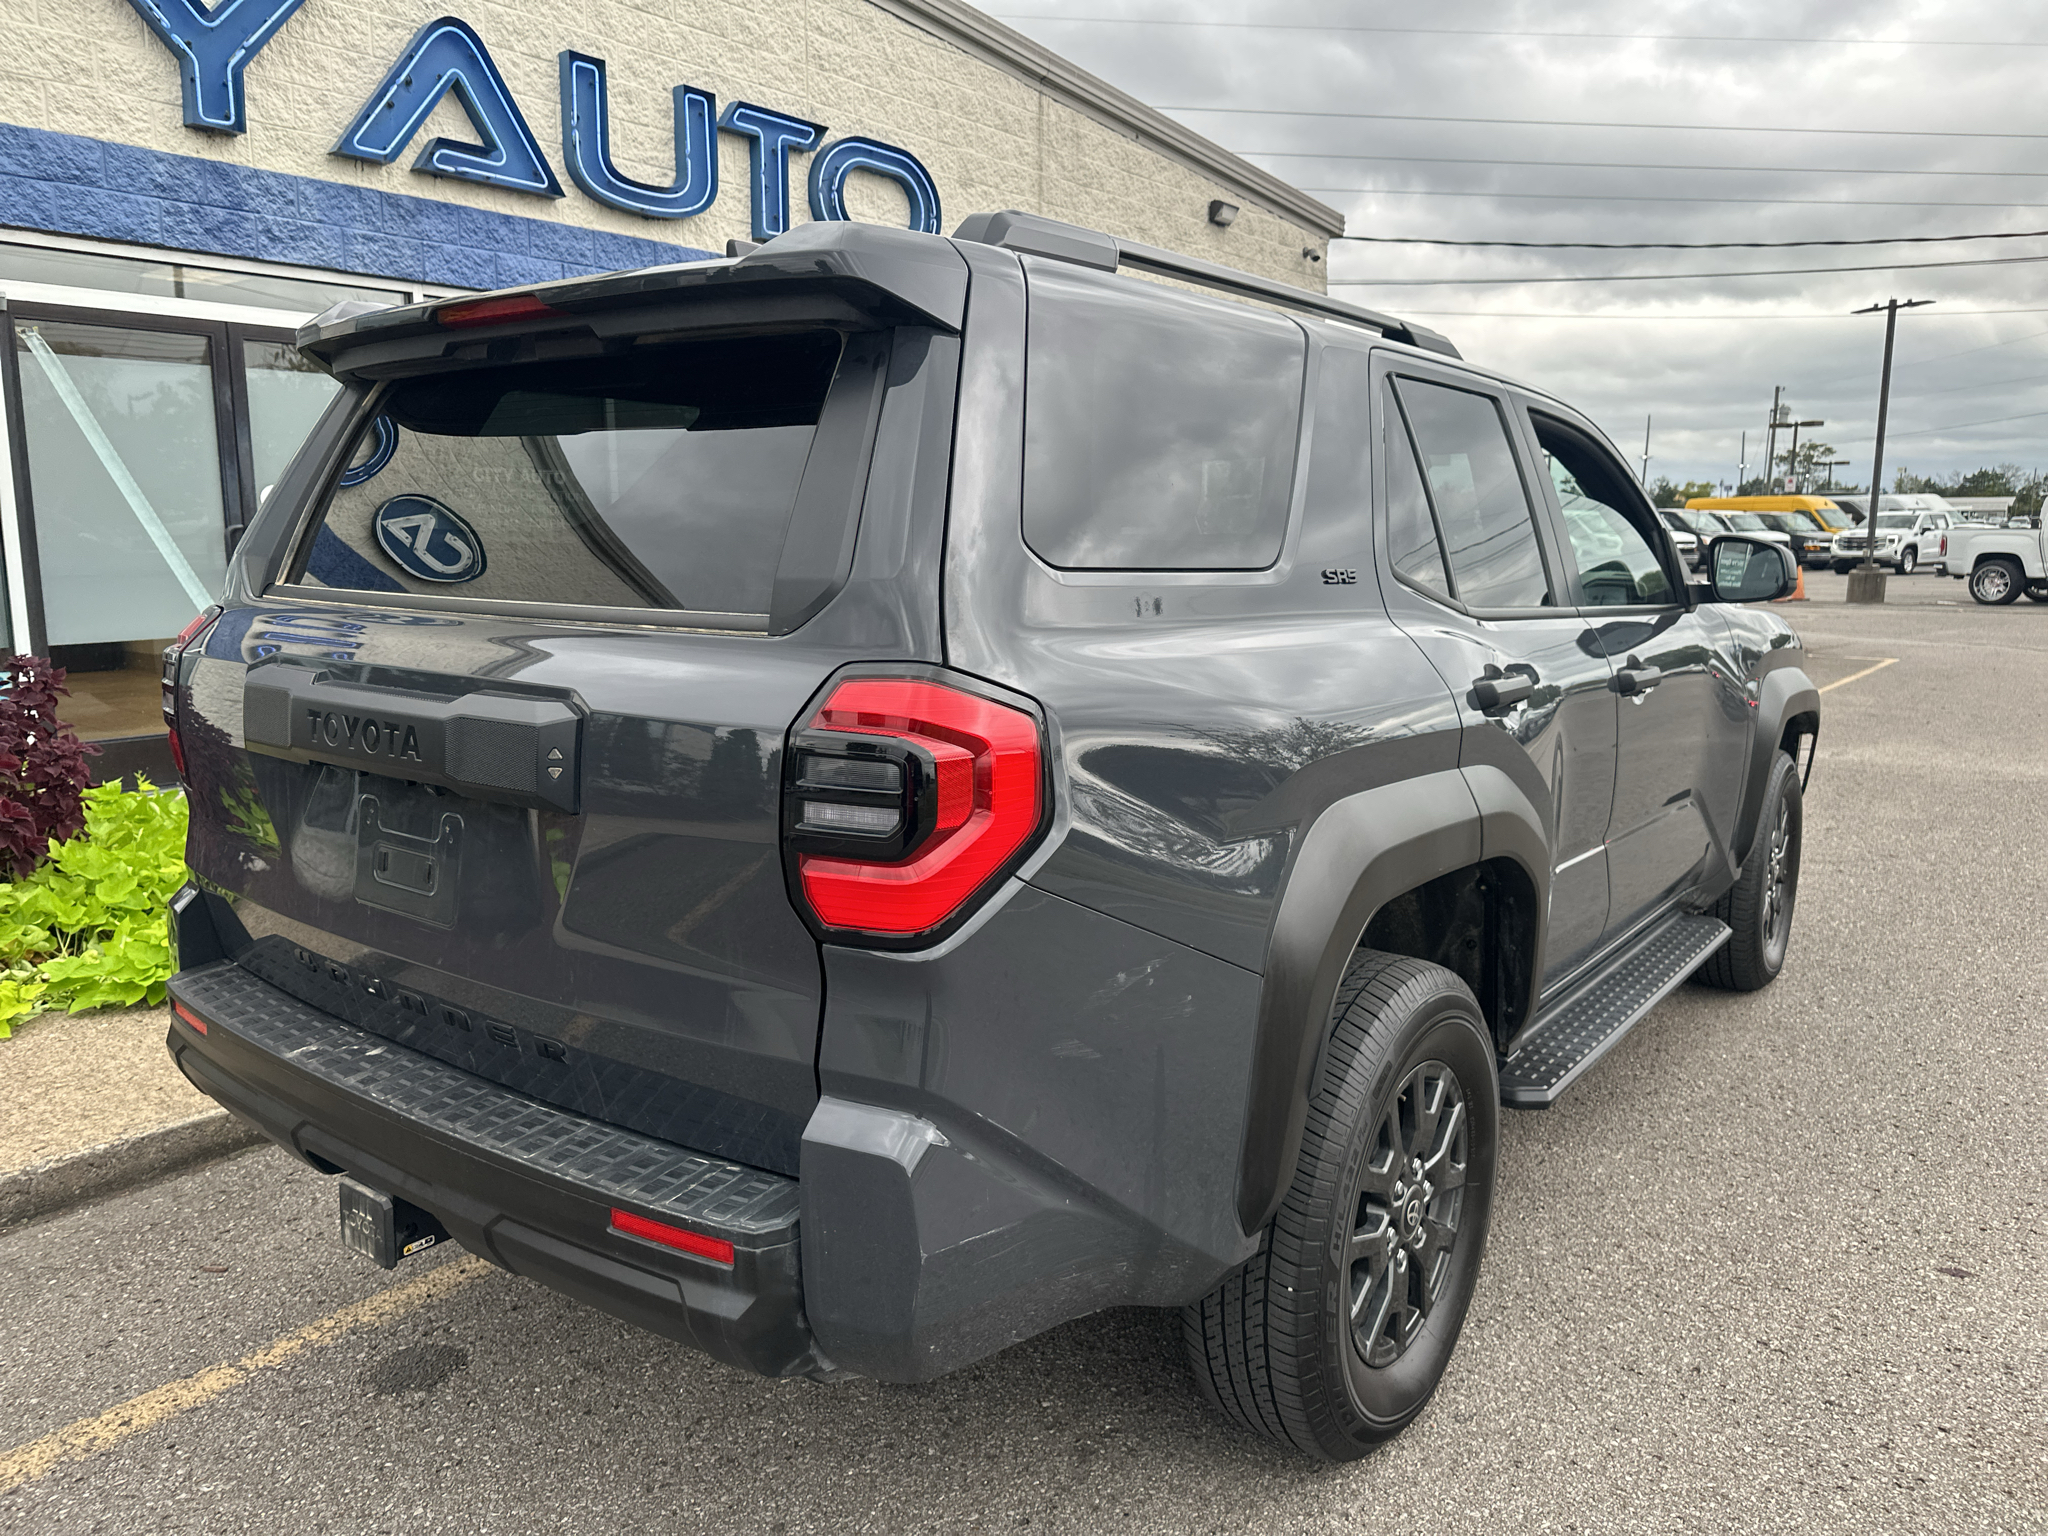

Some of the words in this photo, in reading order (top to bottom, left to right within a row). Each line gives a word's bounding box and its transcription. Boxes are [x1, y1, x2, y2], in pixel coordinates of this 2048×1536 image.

[328, 15, 942, 242] AUTO
[306, 708, 423, 763] TOYOTA
[342, 1209, 383, 1243] TOYOTA
